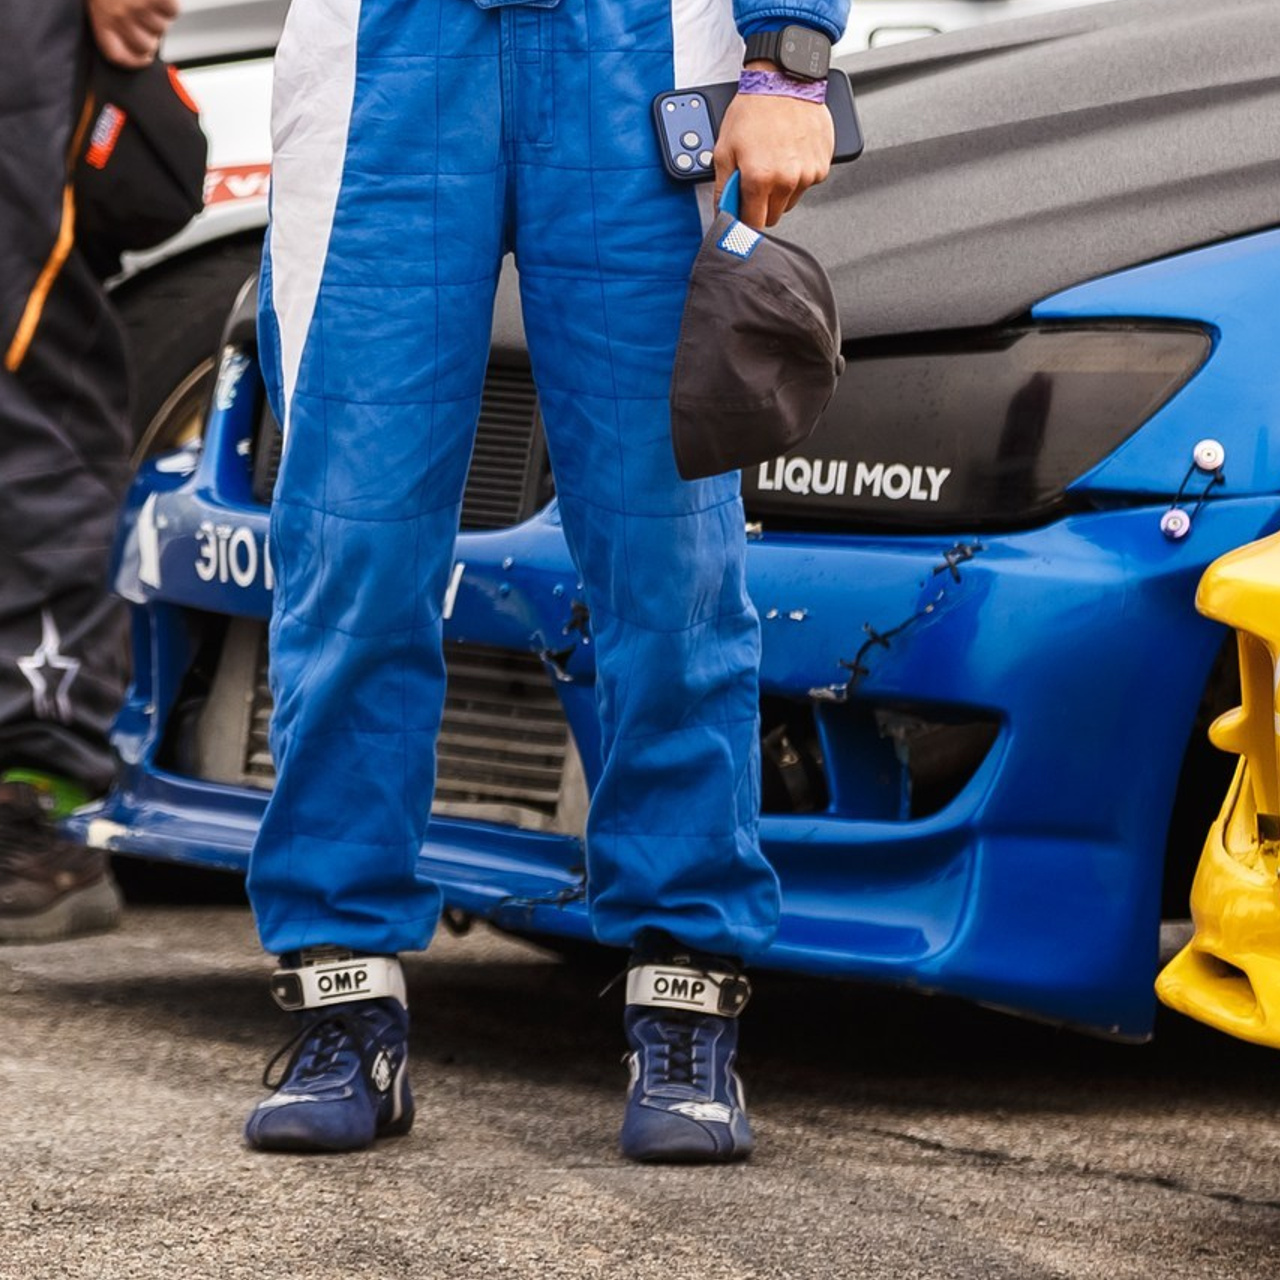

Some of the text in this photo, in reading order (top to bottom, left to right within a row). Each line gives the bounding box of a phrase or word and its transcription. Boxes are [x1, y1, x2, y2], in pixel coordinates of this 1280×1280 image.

[758, 457, 951, 501] LIQUI MOLY
[318, 970, 368, 992] OMP
[654, 977, 706, 999] OMP
